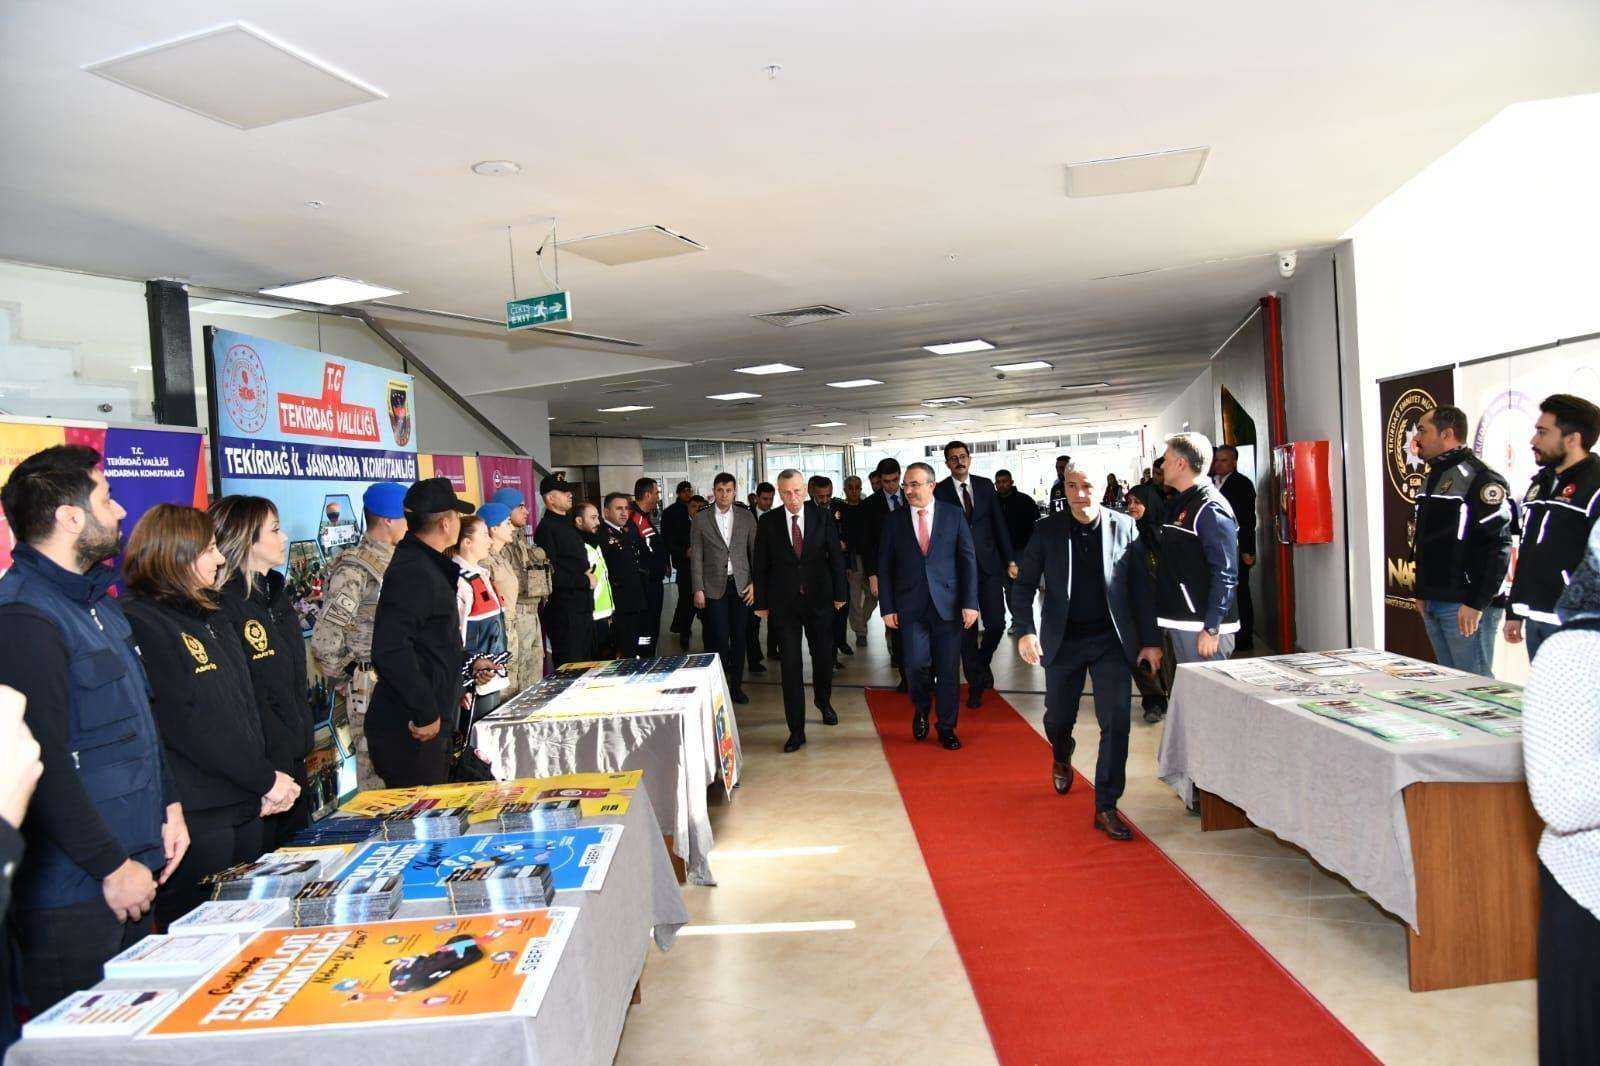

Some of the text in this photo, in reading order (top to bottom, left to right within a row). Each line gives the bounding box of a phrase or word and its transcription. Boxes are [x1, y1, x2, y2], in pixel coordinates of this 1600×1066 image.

[511, 313, 530, 323] EXIT
[280, 400, 377, 437] TEKİRDAĞ VALİLİĞİ
[131, 446, 144, 455] T.C.
[106, 456, 169, 467] TEKİRDAĞ VALİLİĞİ
[224, 443, 416, 479] TEKİRDAĞ İL JANDARMA KOMUTANLIĞI
[103, 468, 185, 478] ANDARMA KOMUTANLIĞI
